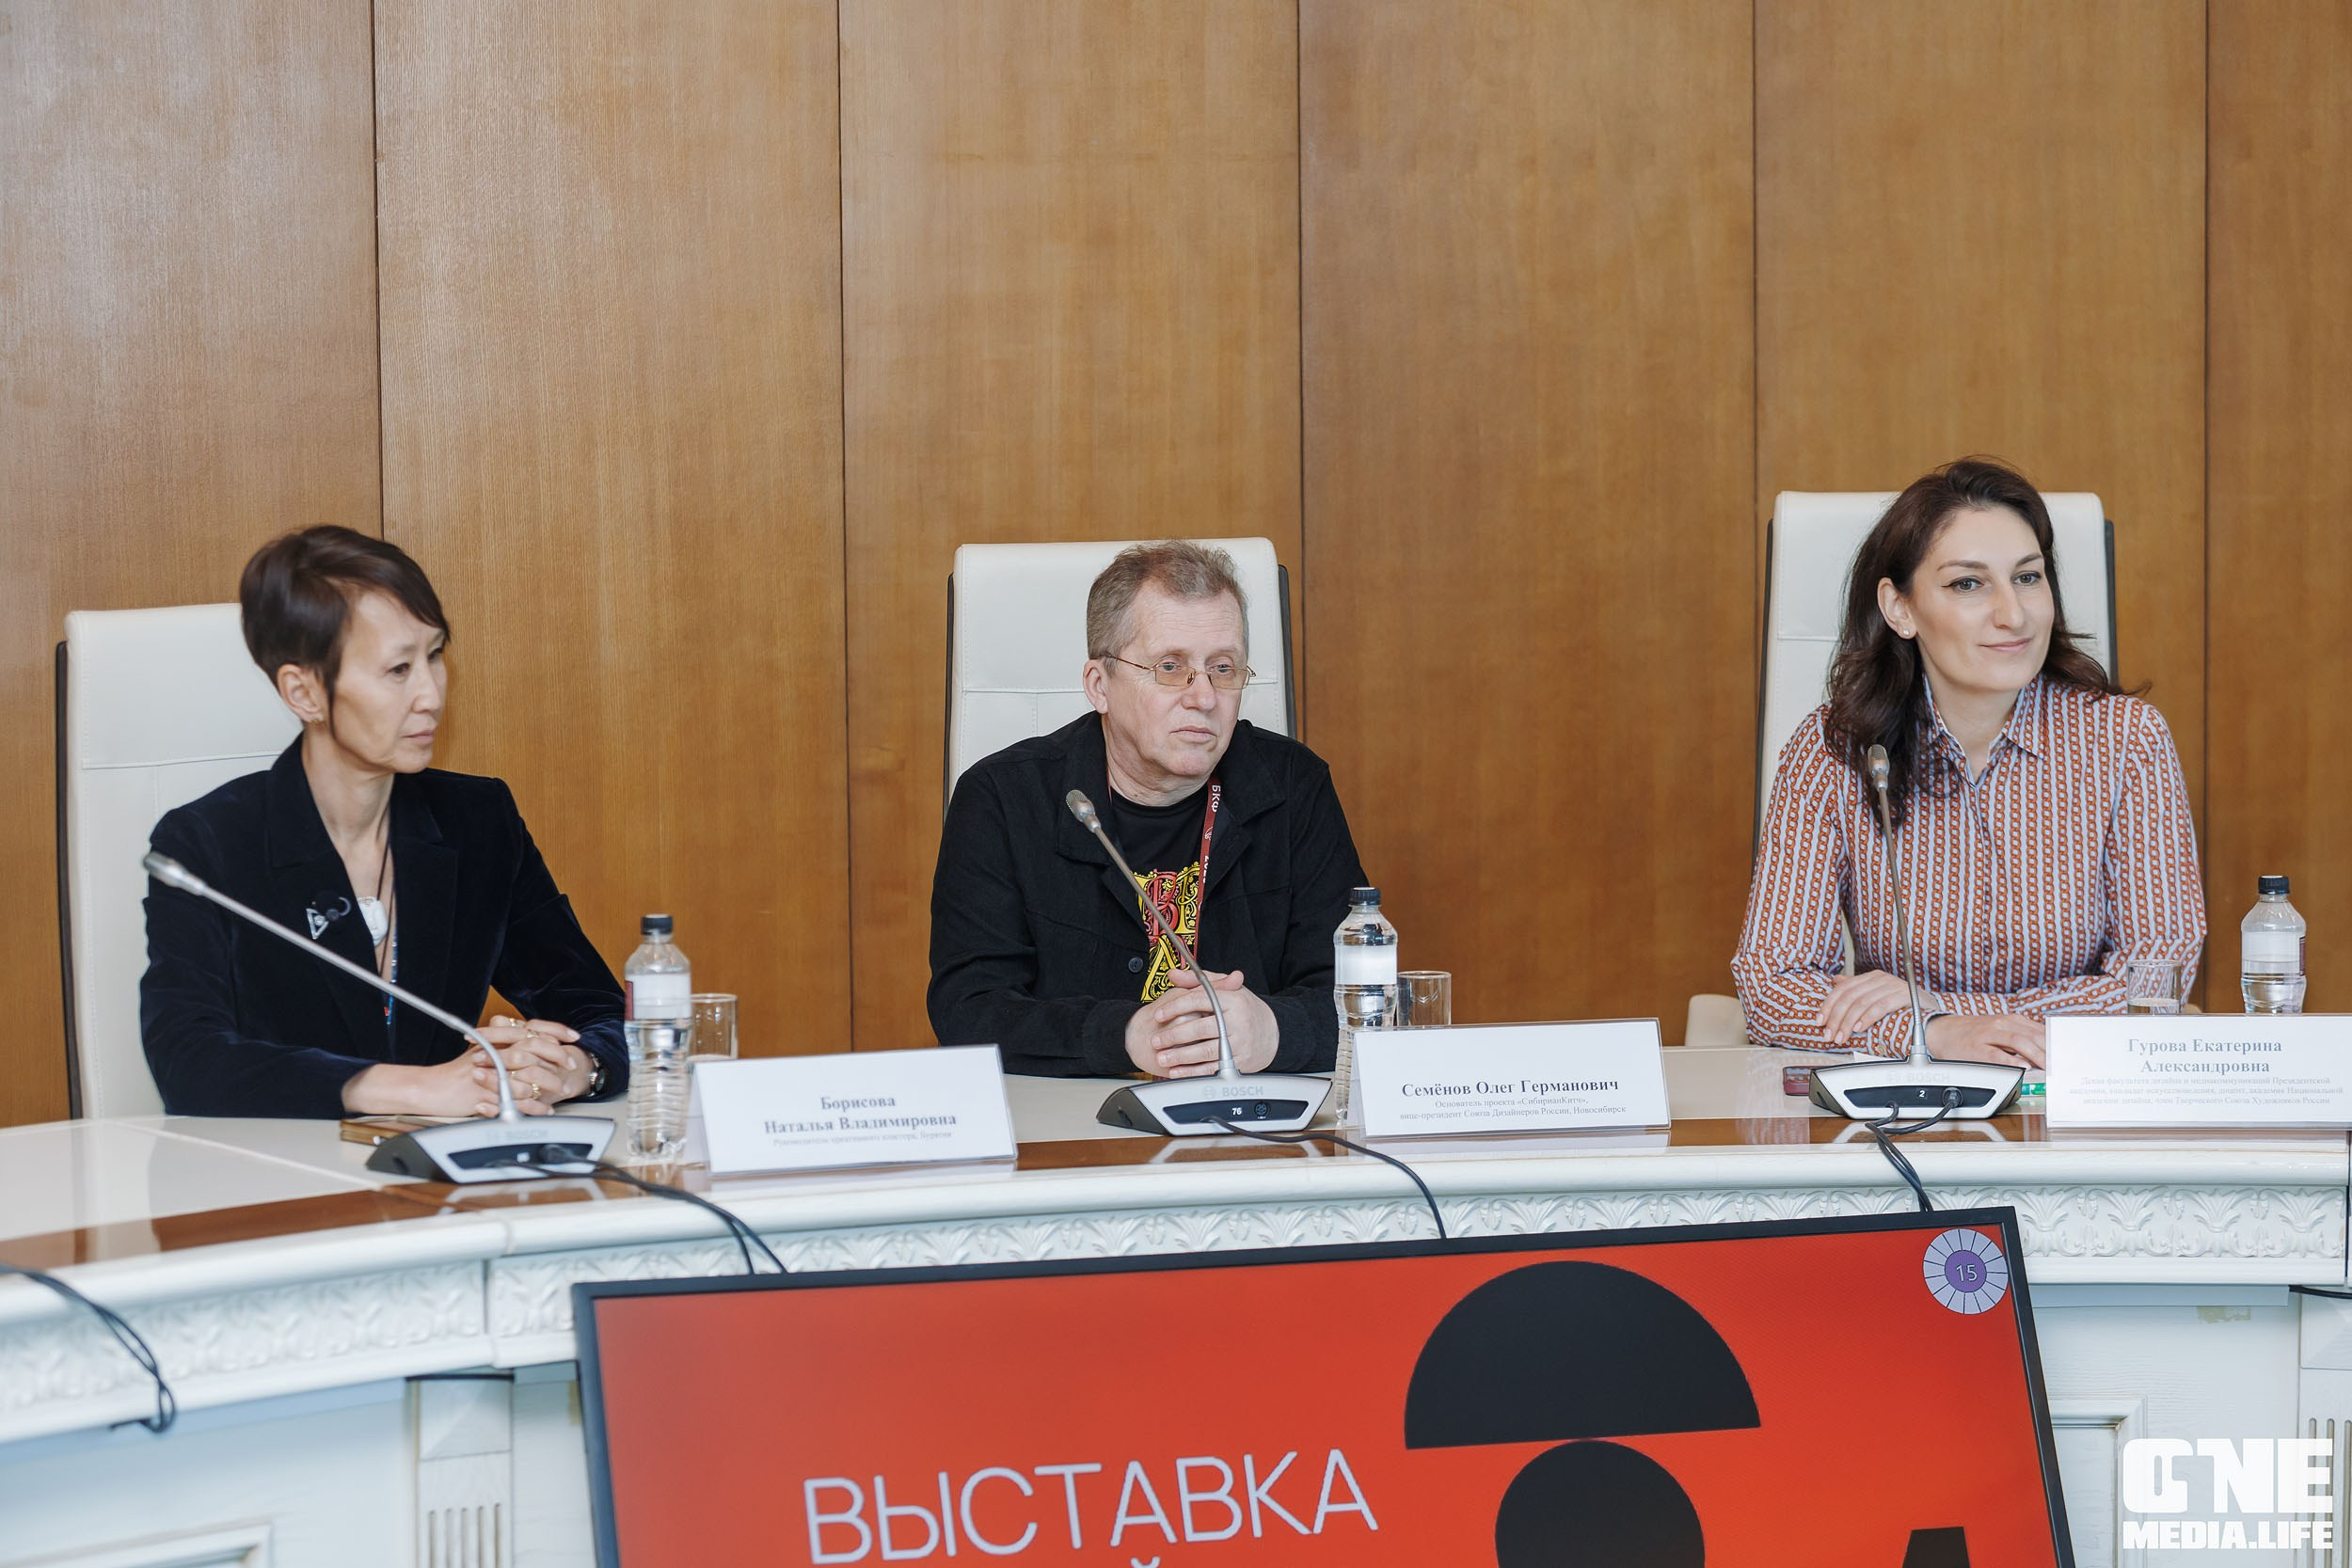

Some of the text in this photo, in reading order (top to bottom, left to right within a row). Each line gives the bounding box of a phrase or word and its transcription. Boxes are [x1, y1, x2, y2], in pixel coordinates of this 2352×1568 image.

[2128, 1038, 2282, 1055] Гурова Екатерина
[2140, 1059, 2270, 1075] Александровна
[1222, 1085, 1264, 1098] BOSCH
[1402, 1080, 1619, 1097] Семёнов Олег Германович
[820, 1097, 896, 1113] Борисова
[1232, 1107, 1243, 1116] 76
[1435, 1100, 1483, 1108] Основатель
[1484, 1099, 1516, 1108] проекта
[1464, 1109, 1491, 1118] Союза
[1492, 1108, 1539, 1117] Дизайнеров
[1573, 1105, 1627, 1115] Новосибирск
[764, 1115, 957, 1134] Наталья Владимировна
[1956, 1264, 1978, 1282] 15
[803, 1449, 1379, 1565] ВЫСТАВКА
